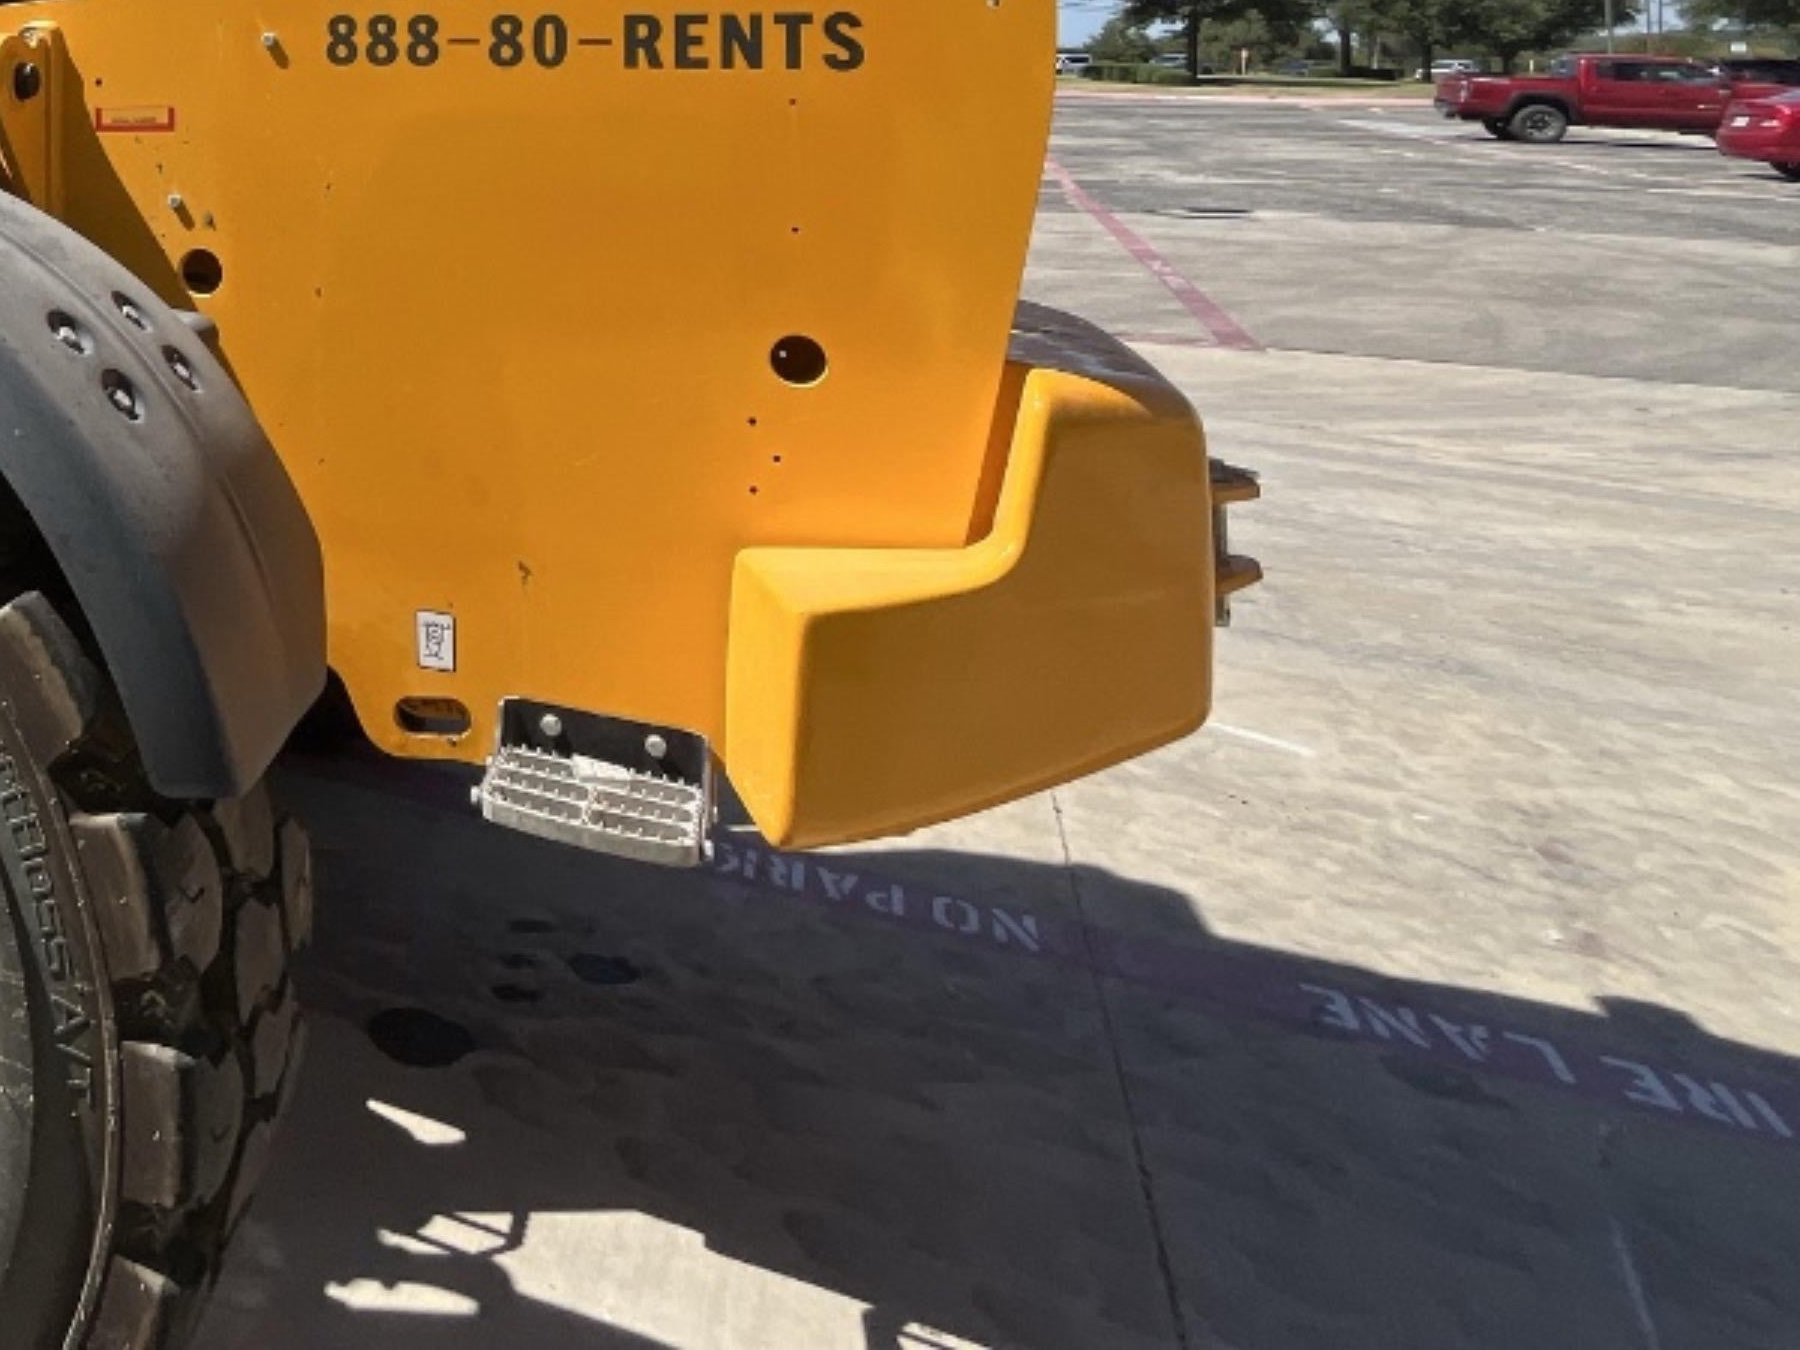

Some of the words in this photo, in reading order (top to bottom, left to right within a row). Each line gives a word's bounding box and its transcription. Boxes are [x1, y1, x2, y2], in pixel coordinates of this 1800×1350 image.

[325, 10, 867, 72] 888-80-RENTS
[931, 895, 1041, 952] NO
[1299, 982, 1577, 1084] LANE
